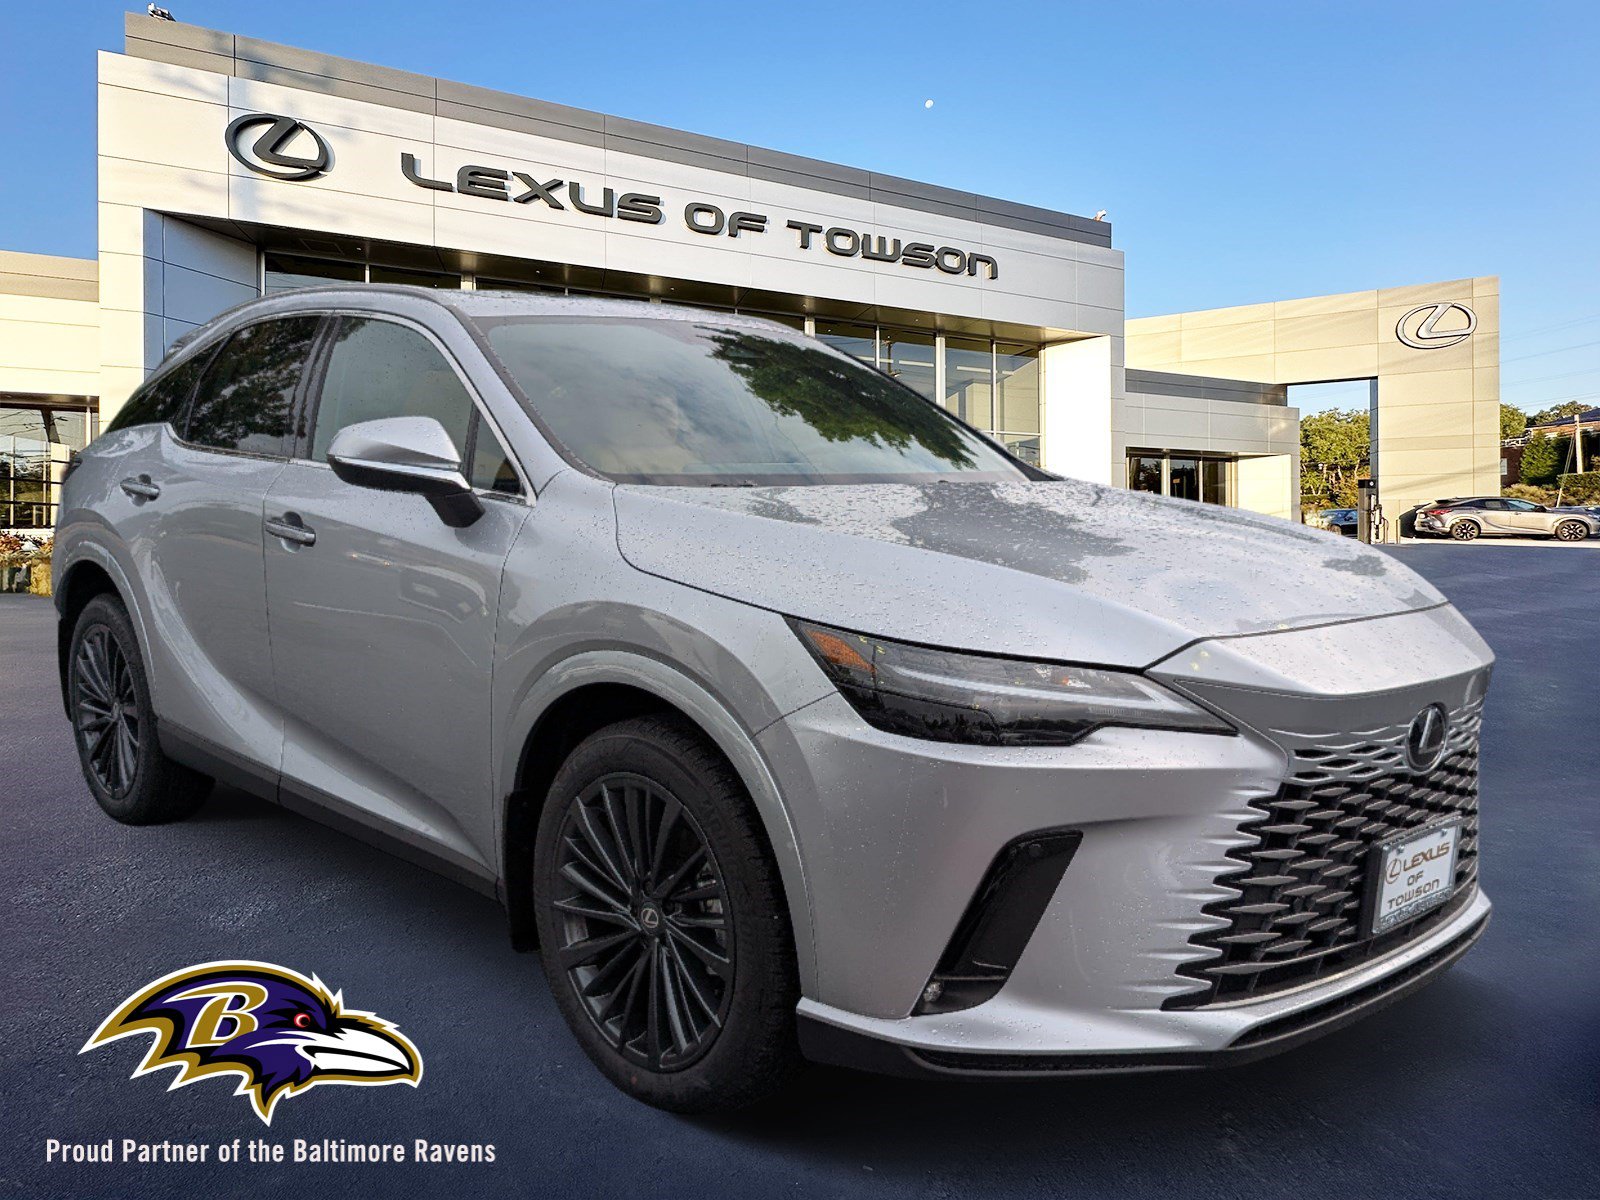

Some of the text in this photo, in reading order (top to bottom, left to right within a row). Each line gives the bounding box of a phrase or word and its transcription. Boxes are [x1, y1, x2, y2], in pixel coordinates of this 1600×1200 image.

[401, 152, 999, 280] LEXUS OF TOWSON
[1403, 841, 1451, 872] LEXUS
[1387, 878, 1440, 910] TOWSON
[1407, 870, 1424, 887] OF
